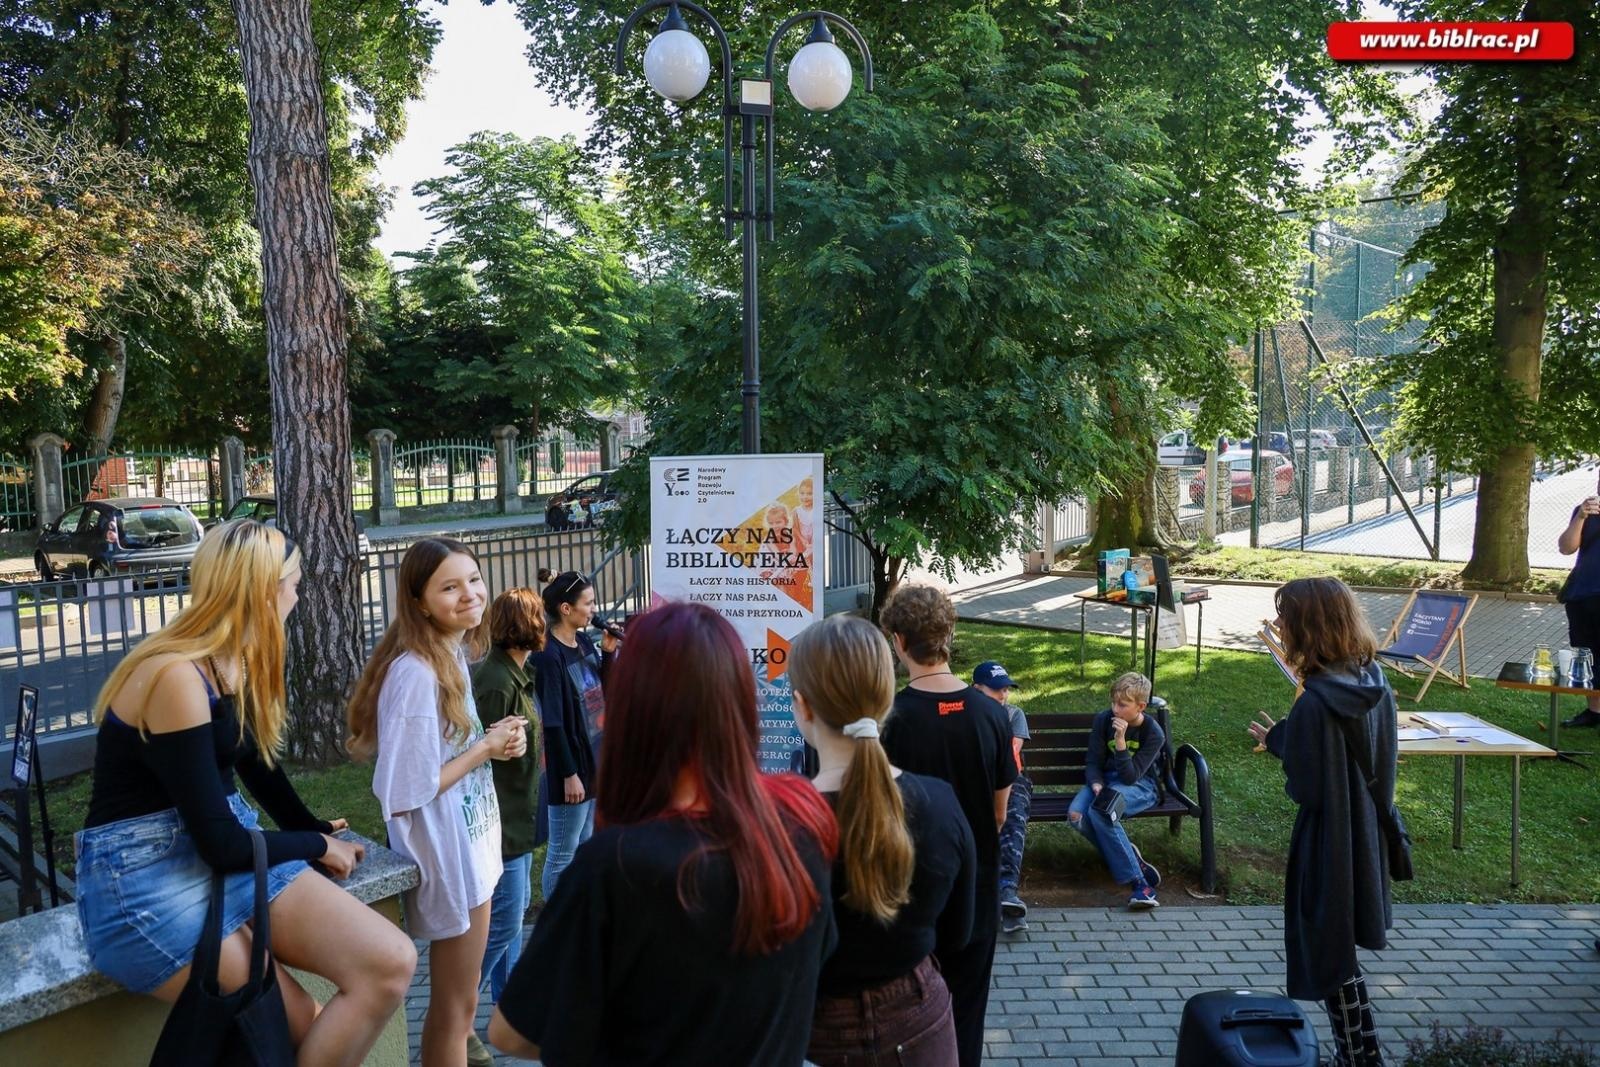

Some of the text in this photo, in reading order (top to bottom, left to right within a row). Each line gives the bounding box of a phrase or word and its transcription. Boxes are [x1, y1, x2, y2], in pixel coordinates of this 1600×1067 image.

[666, 528, 793, 547] ŁĄCZY NAS
[666, 552, 809, 569] BIBLIOTEKA
[689, 577, 796, 587] ŁĄCZY NAS HISTORIA
[689, 593, 778, 602] ŁĄCZY NAS PASJA
[725, 609, 744, 617] NAS
[747, 609, 803, 618] PRZYRODA
